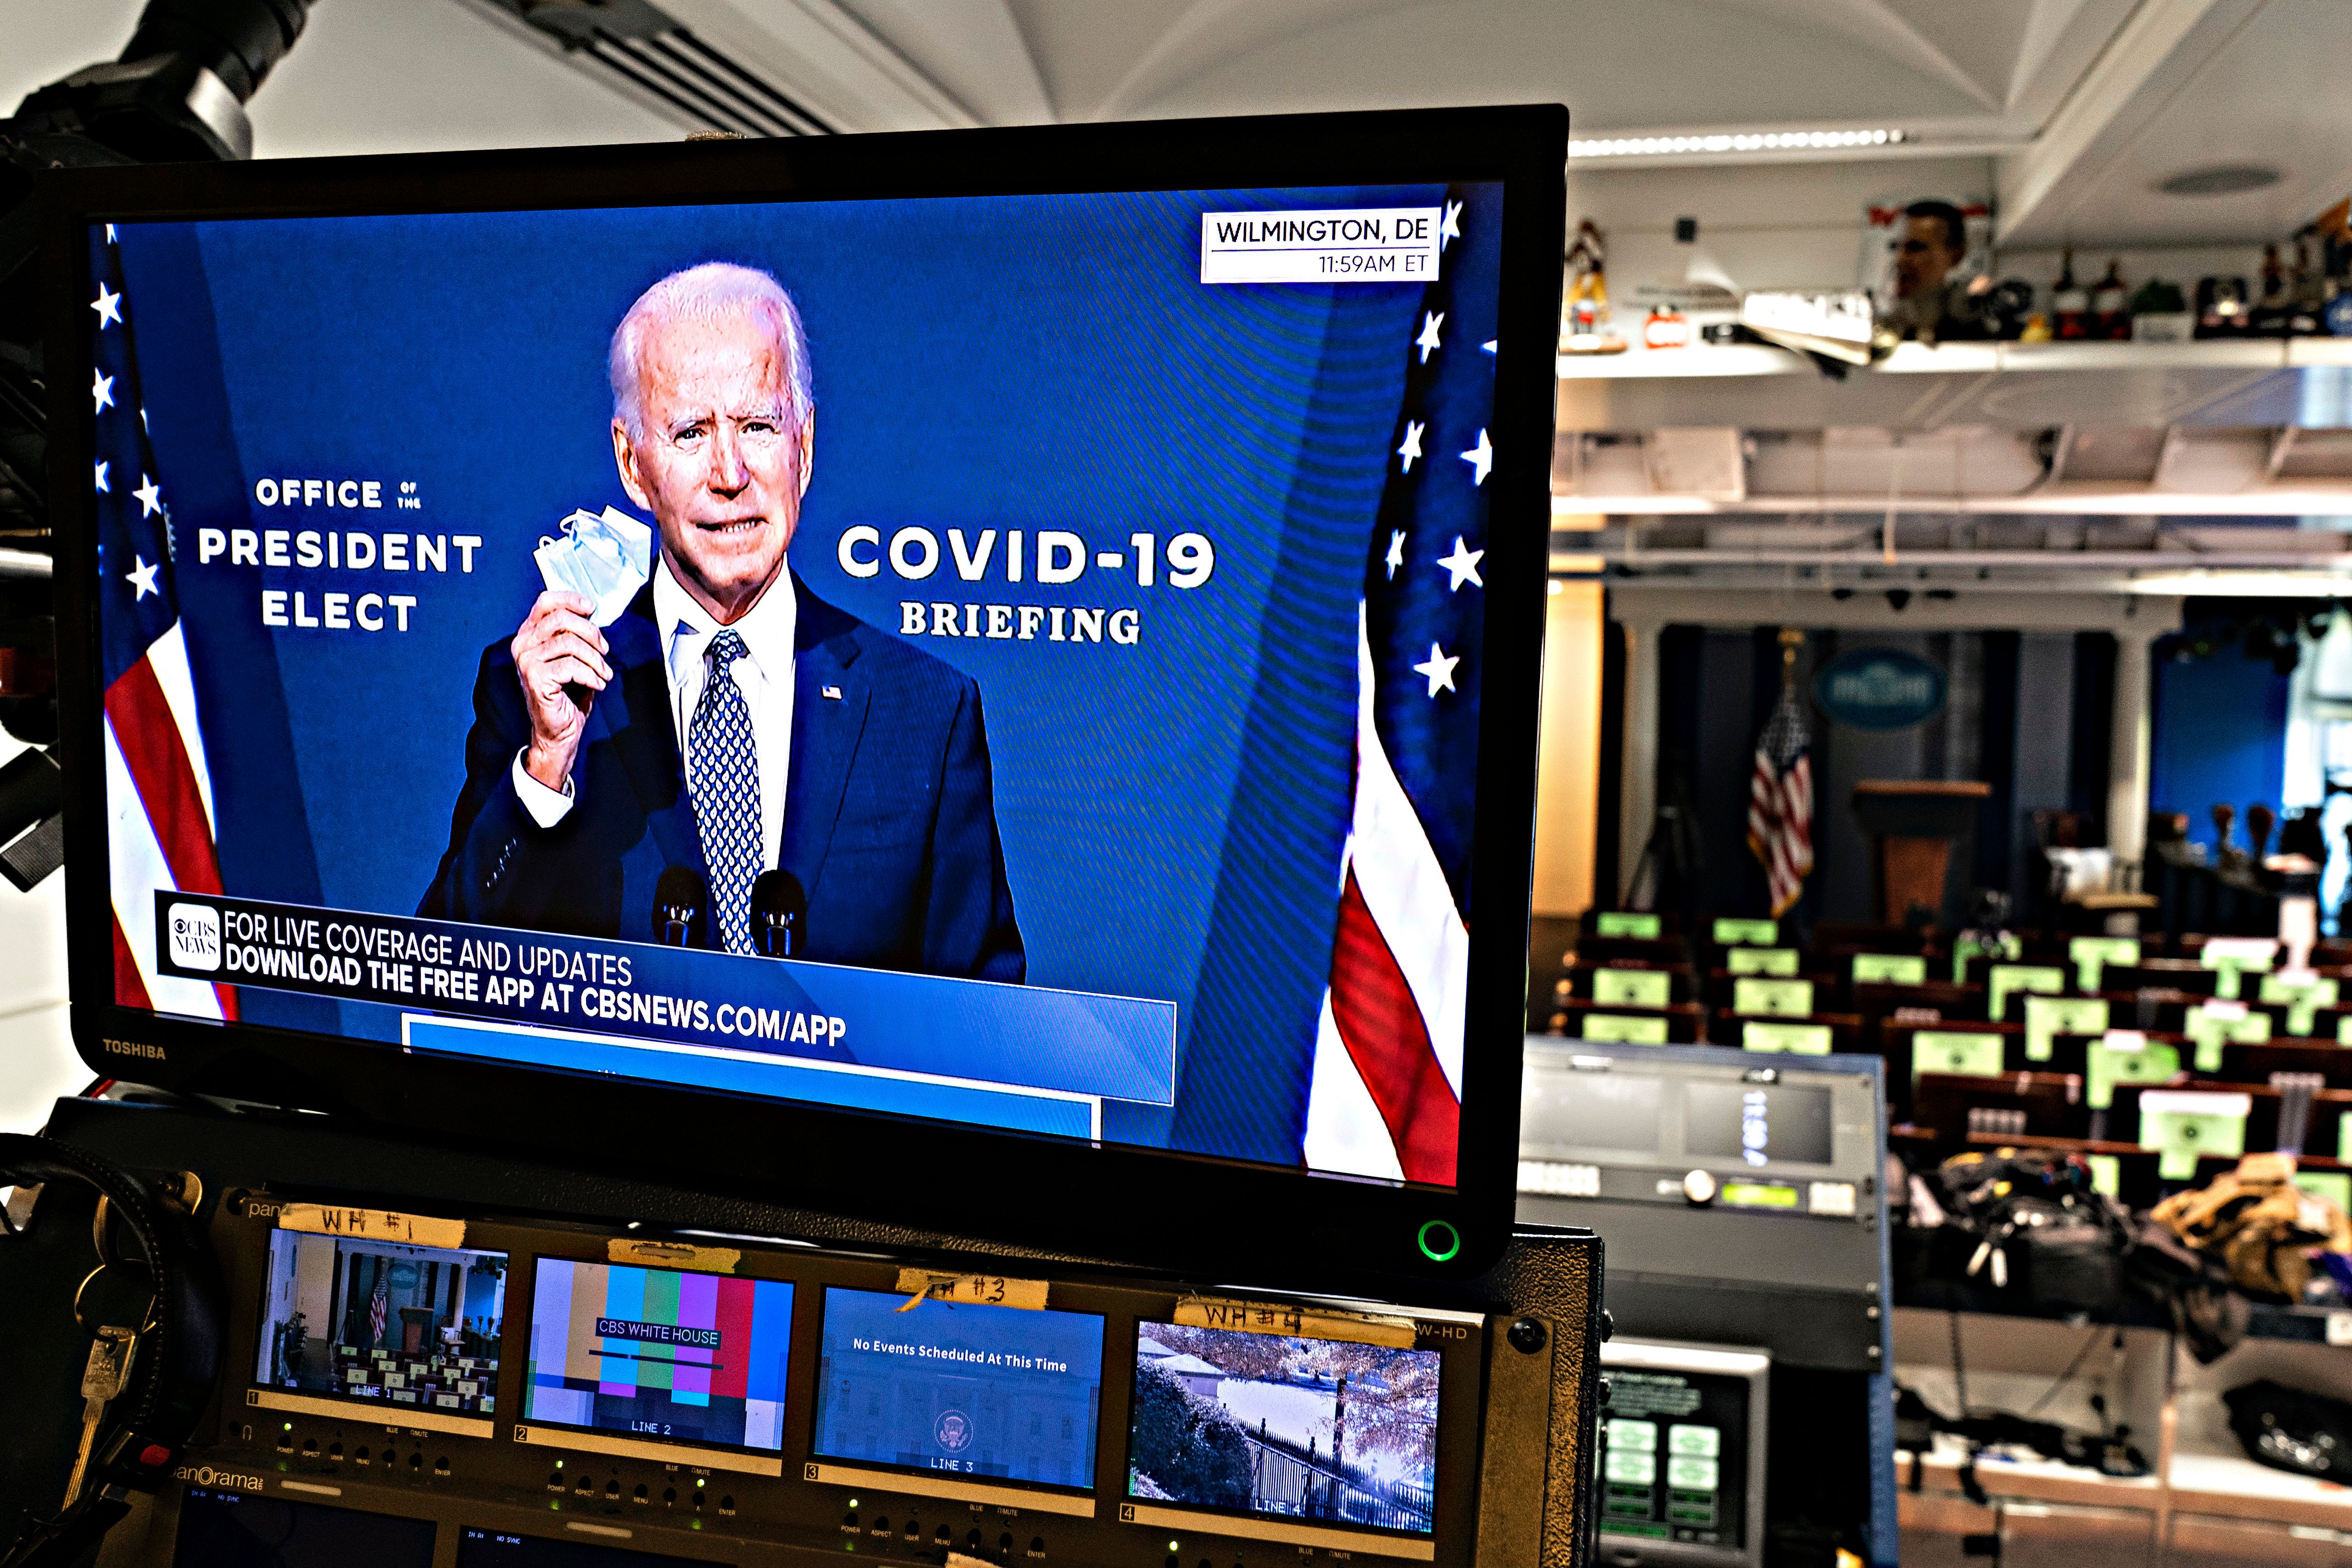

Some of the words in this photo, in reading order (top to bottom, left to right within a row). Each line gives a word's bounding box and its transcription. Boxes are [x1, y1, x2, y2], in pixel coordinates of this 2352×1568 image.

[1217, 219, 1385, 243] WILMINGTON,
[1395, 219, 1428, 239] DE
[1319, 255, 1395, 273] 11:59AM
[1406, 255, 1428, 272] ET
[256, 478, 382, 508] OFFICE
[400, 482, 416, 493] OF
[398, 497, 421, 509] THE
[199, 528, 482, 573] PRESIDENT
[838, 524, 1216, 588] COVID-19
[263, 590, 417, 631] ELECT
[900, 601, 1140, 645] BRIEFING
[187, 920, 216, 937] CBS
[175, 935, 216, 956] NEWS
[224, 911, 267, 943] FOR
[274, 916, 320, 949] LIVE
[326, 923, 452, 968] COVERAGE
[459, 939, 511, 972] AND
[519, 945, 632, 987] UPDATES
[226, 943, 361, 986] DOWNLOAD
[367, 960, 413, 994] THE
[421, 967, 479, 1002] FREE
[485, 975, 534, 1008] APP
[541, 982, 574, 1013] AT
[581, 987, 846, 1047] CBSNEWS.COM/APP
[103, 1038, 166, 1060] TOSHIBA
[1205, 1305, 1247, 1327] WH
[599, 1320, 625, 1334] CBS
[629, 1322, 669, 1340] WHITE
[673, 1328, 718, 1345] HOUSE
[853, 1338, 870, 1351] No
[873, 1340, 915, 1355] Events
[919, 1345, 985, 1363] Scheduled
[987, 1353, 1002, 1366] At
[1005, 1355, 1031, 1369] This
[1035, 1358, 1067, 1372] Time
[251, 1393, 256, 1404] 1
[356, 1385, 379, 1397] LINE
[386, 1389, 391, 1398] 1
[518, 1428, 525, 1440] 2
[632, 1420, 658, 1433] LINE
[664, 1425, 671, 1435] 2
[809, 1466, 816, 1479] 3
[931, 1457, 959, 1471] LINE
[966, 1461, 974, 1473] 3
[547, 1484, 565, 1492] POWER
[575, 1488, 595, 1497] ASPECT
[1124, 1506, 1132, 1519] 4
[1256, 1499, 1286, 1513] LINE
[1294, 1504, 1302, 1515] 4
[841, 1525, 860, 1534] POWER
[871, 1529, 892, 1538] ASPECT
[935, 1538, 951, 1546] MENU
[1028, 1550, 1045, 1559] ENTER
[1298, 1546, 1313, 1555] BLUE
